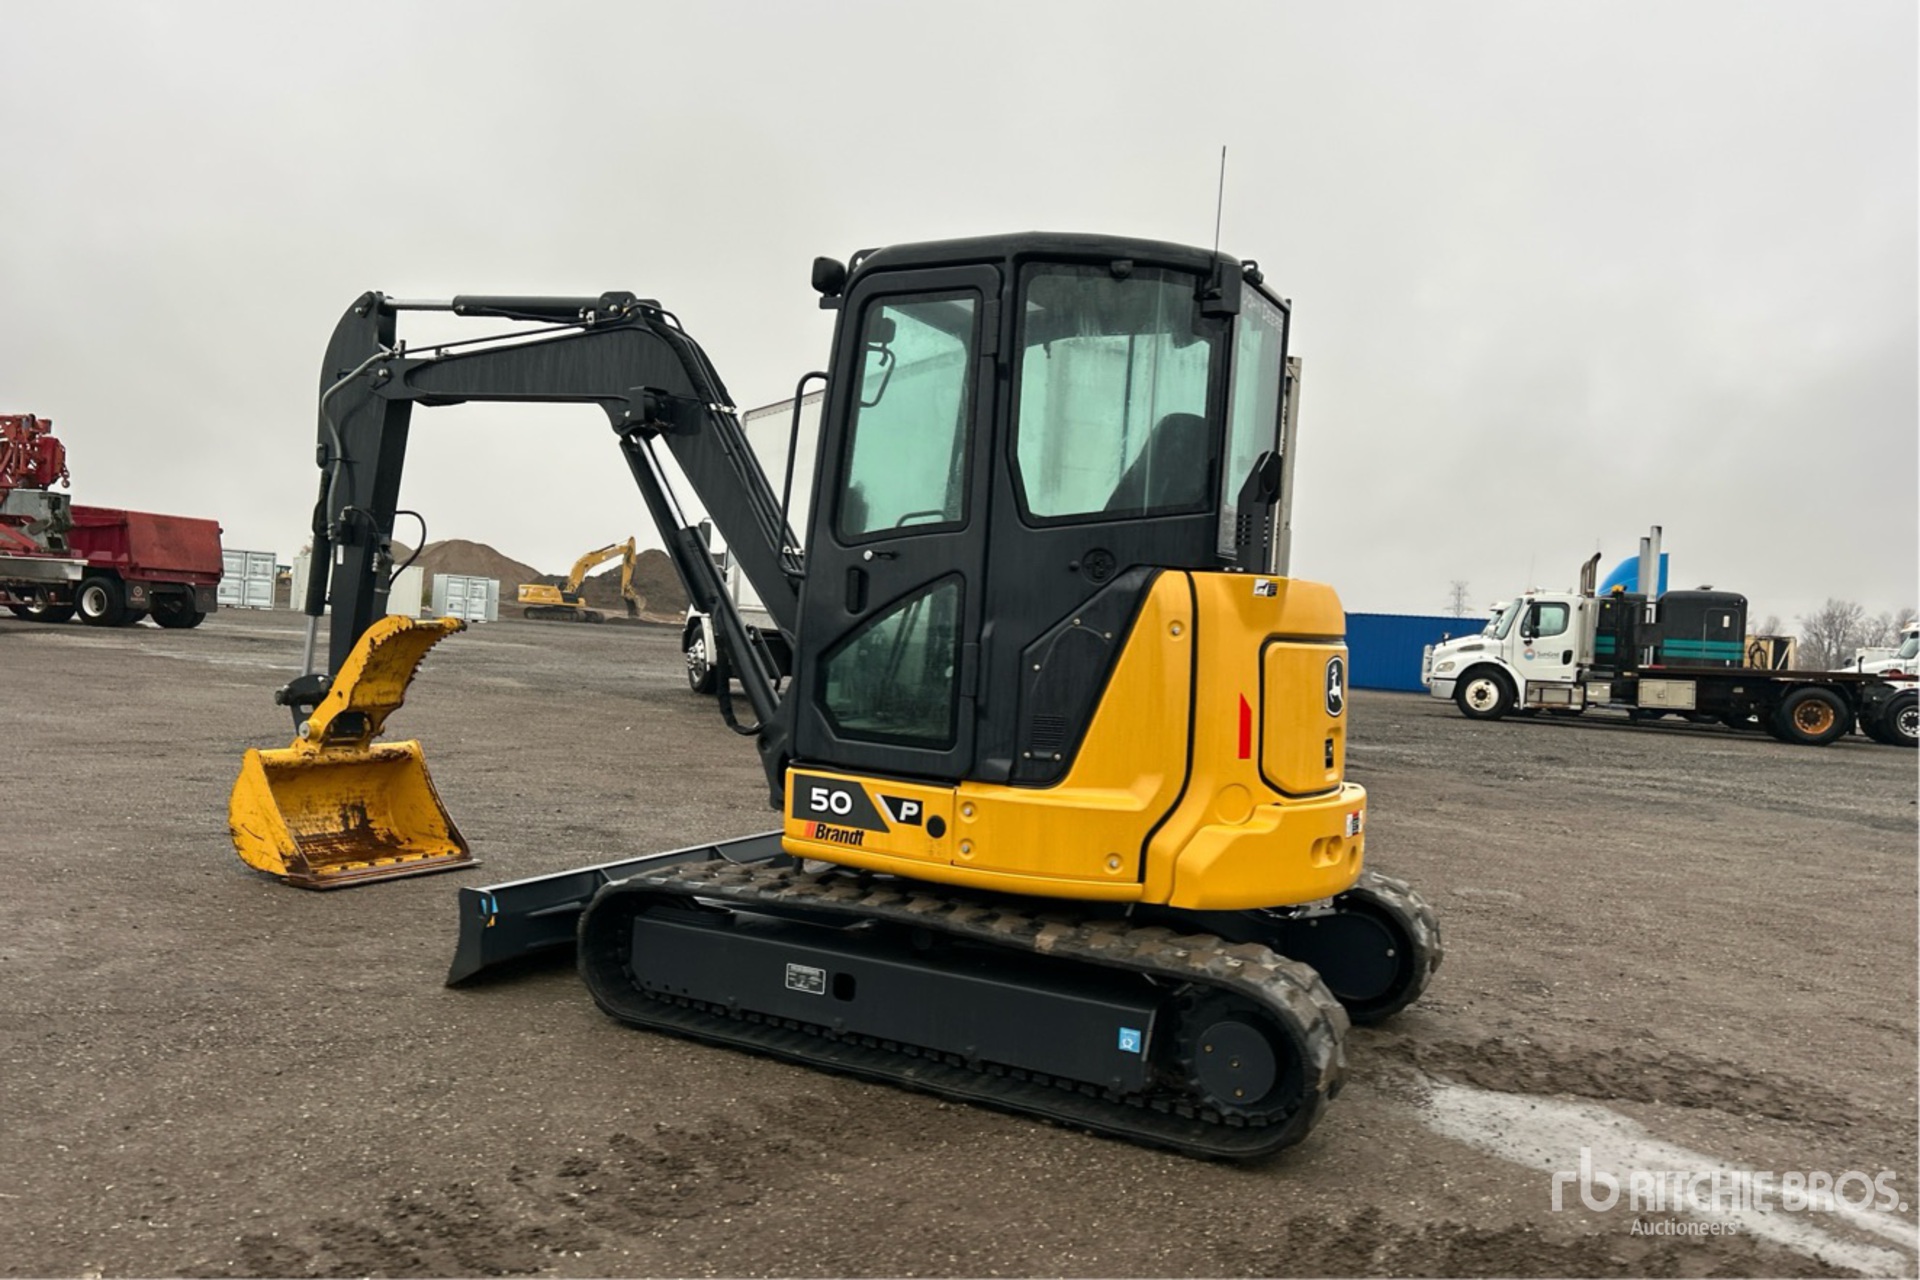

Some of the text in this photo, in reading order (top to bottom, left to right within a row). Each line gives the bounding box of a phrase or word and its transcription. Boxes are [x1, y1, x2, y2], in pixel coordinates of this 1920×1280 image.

[811, 787, 919, 821] 50 P
[815, 823, 865, 846] Brandt
